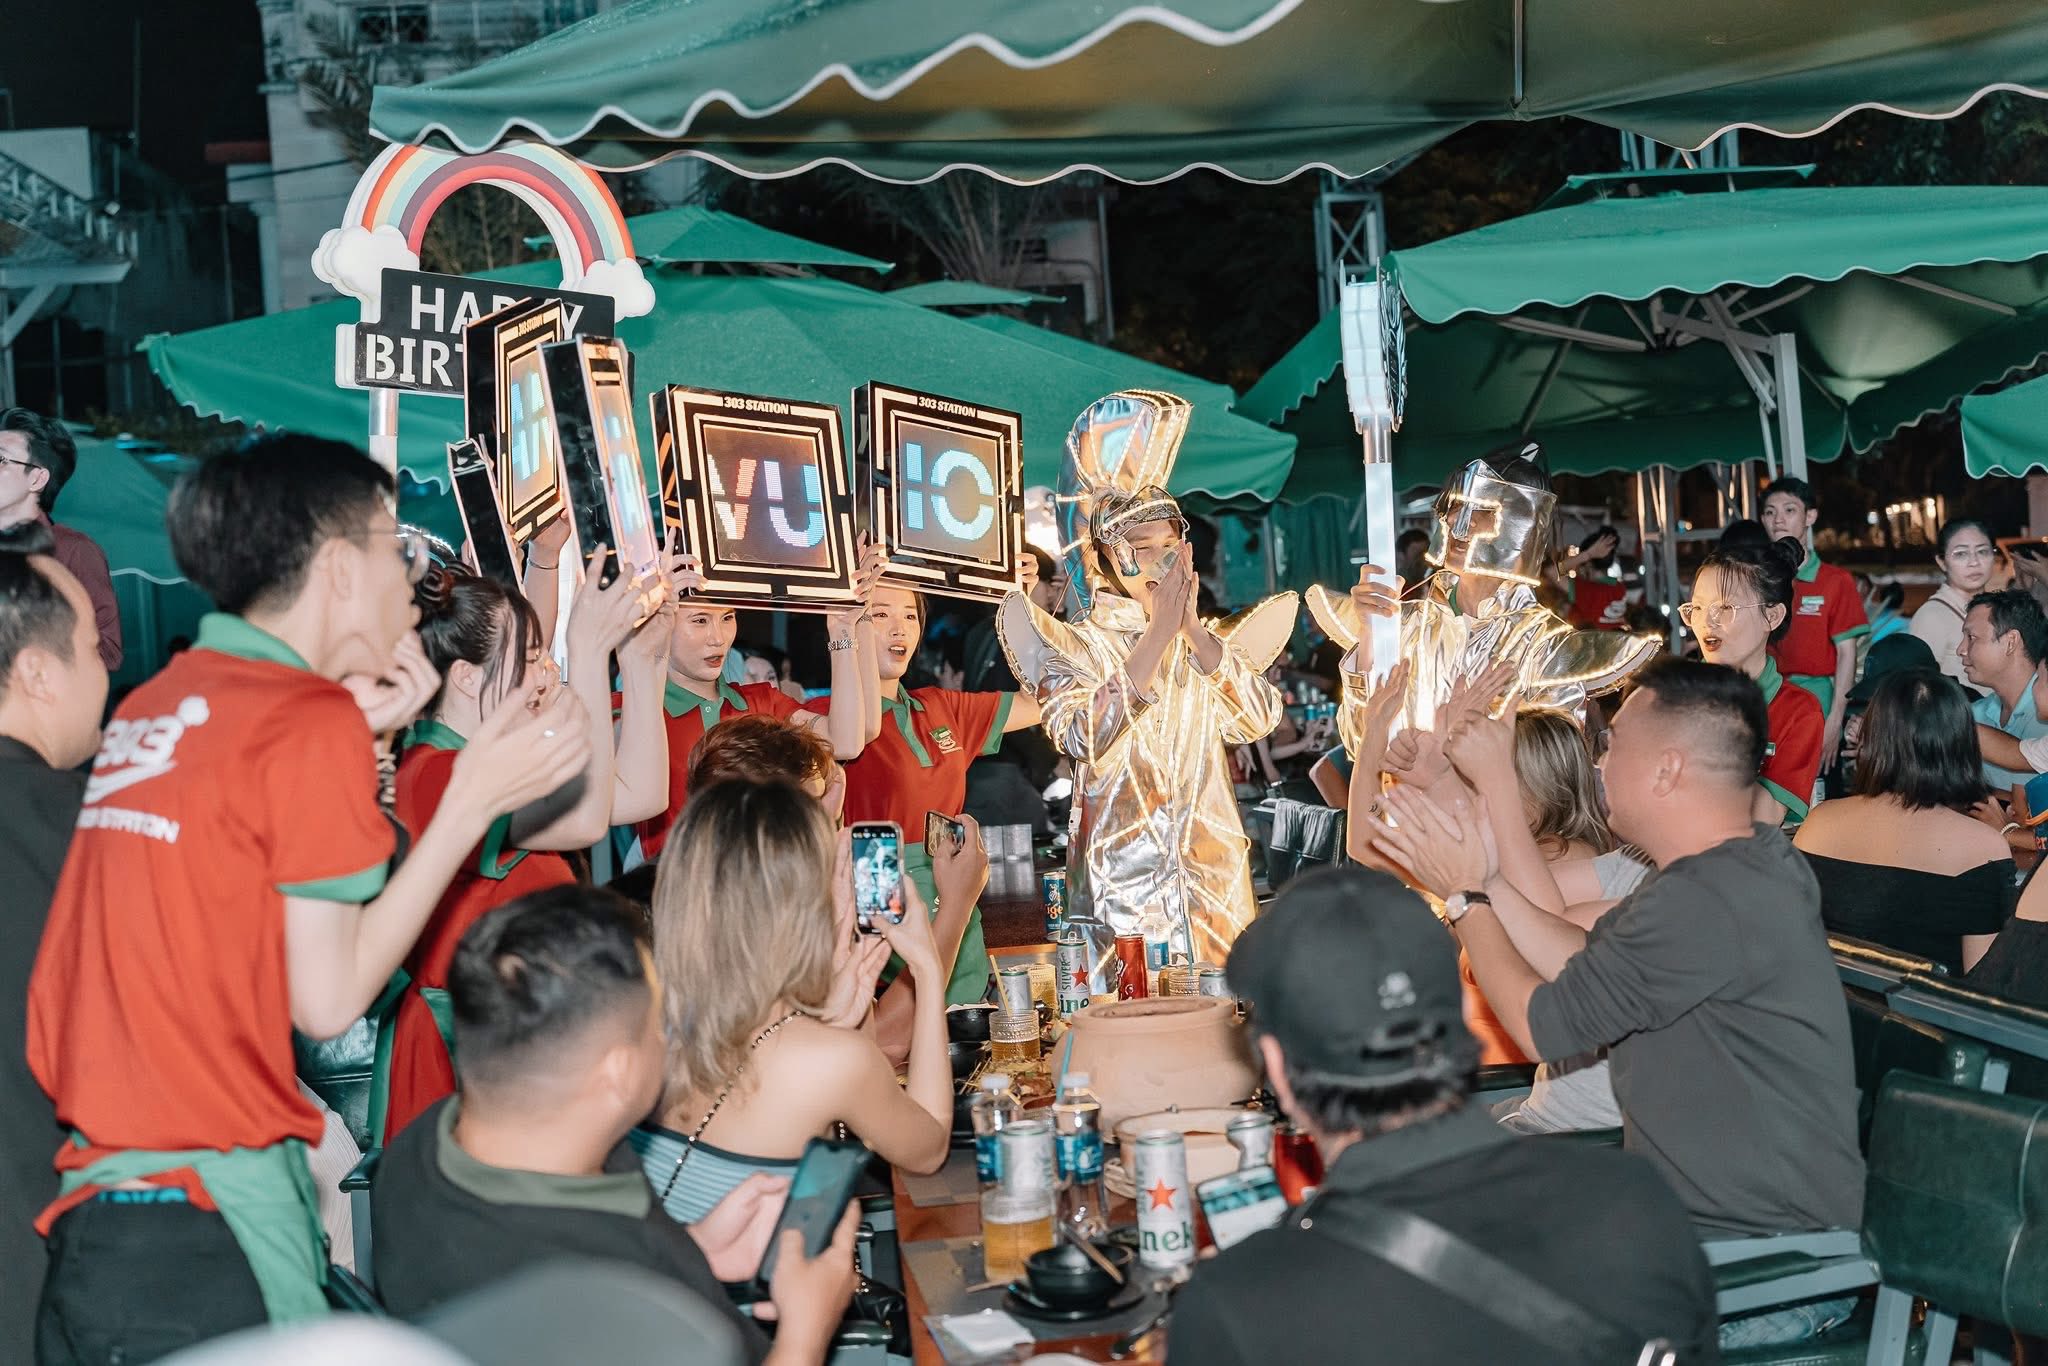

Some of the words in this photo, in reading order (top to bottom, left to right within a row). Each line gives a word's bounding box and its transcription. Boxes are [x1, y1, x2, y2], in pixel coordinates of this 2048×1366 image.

[411, 285, 584, 338] HAY
[366, 334, 464, 387] BIR
[724, 397, 744, 410] 303
[745, 399, 789, 415] STATION
[919, 396, 937, 409] 303
[937, 401, 977, 418] STATION
[1061, 961, 1072, 991] SILVER
